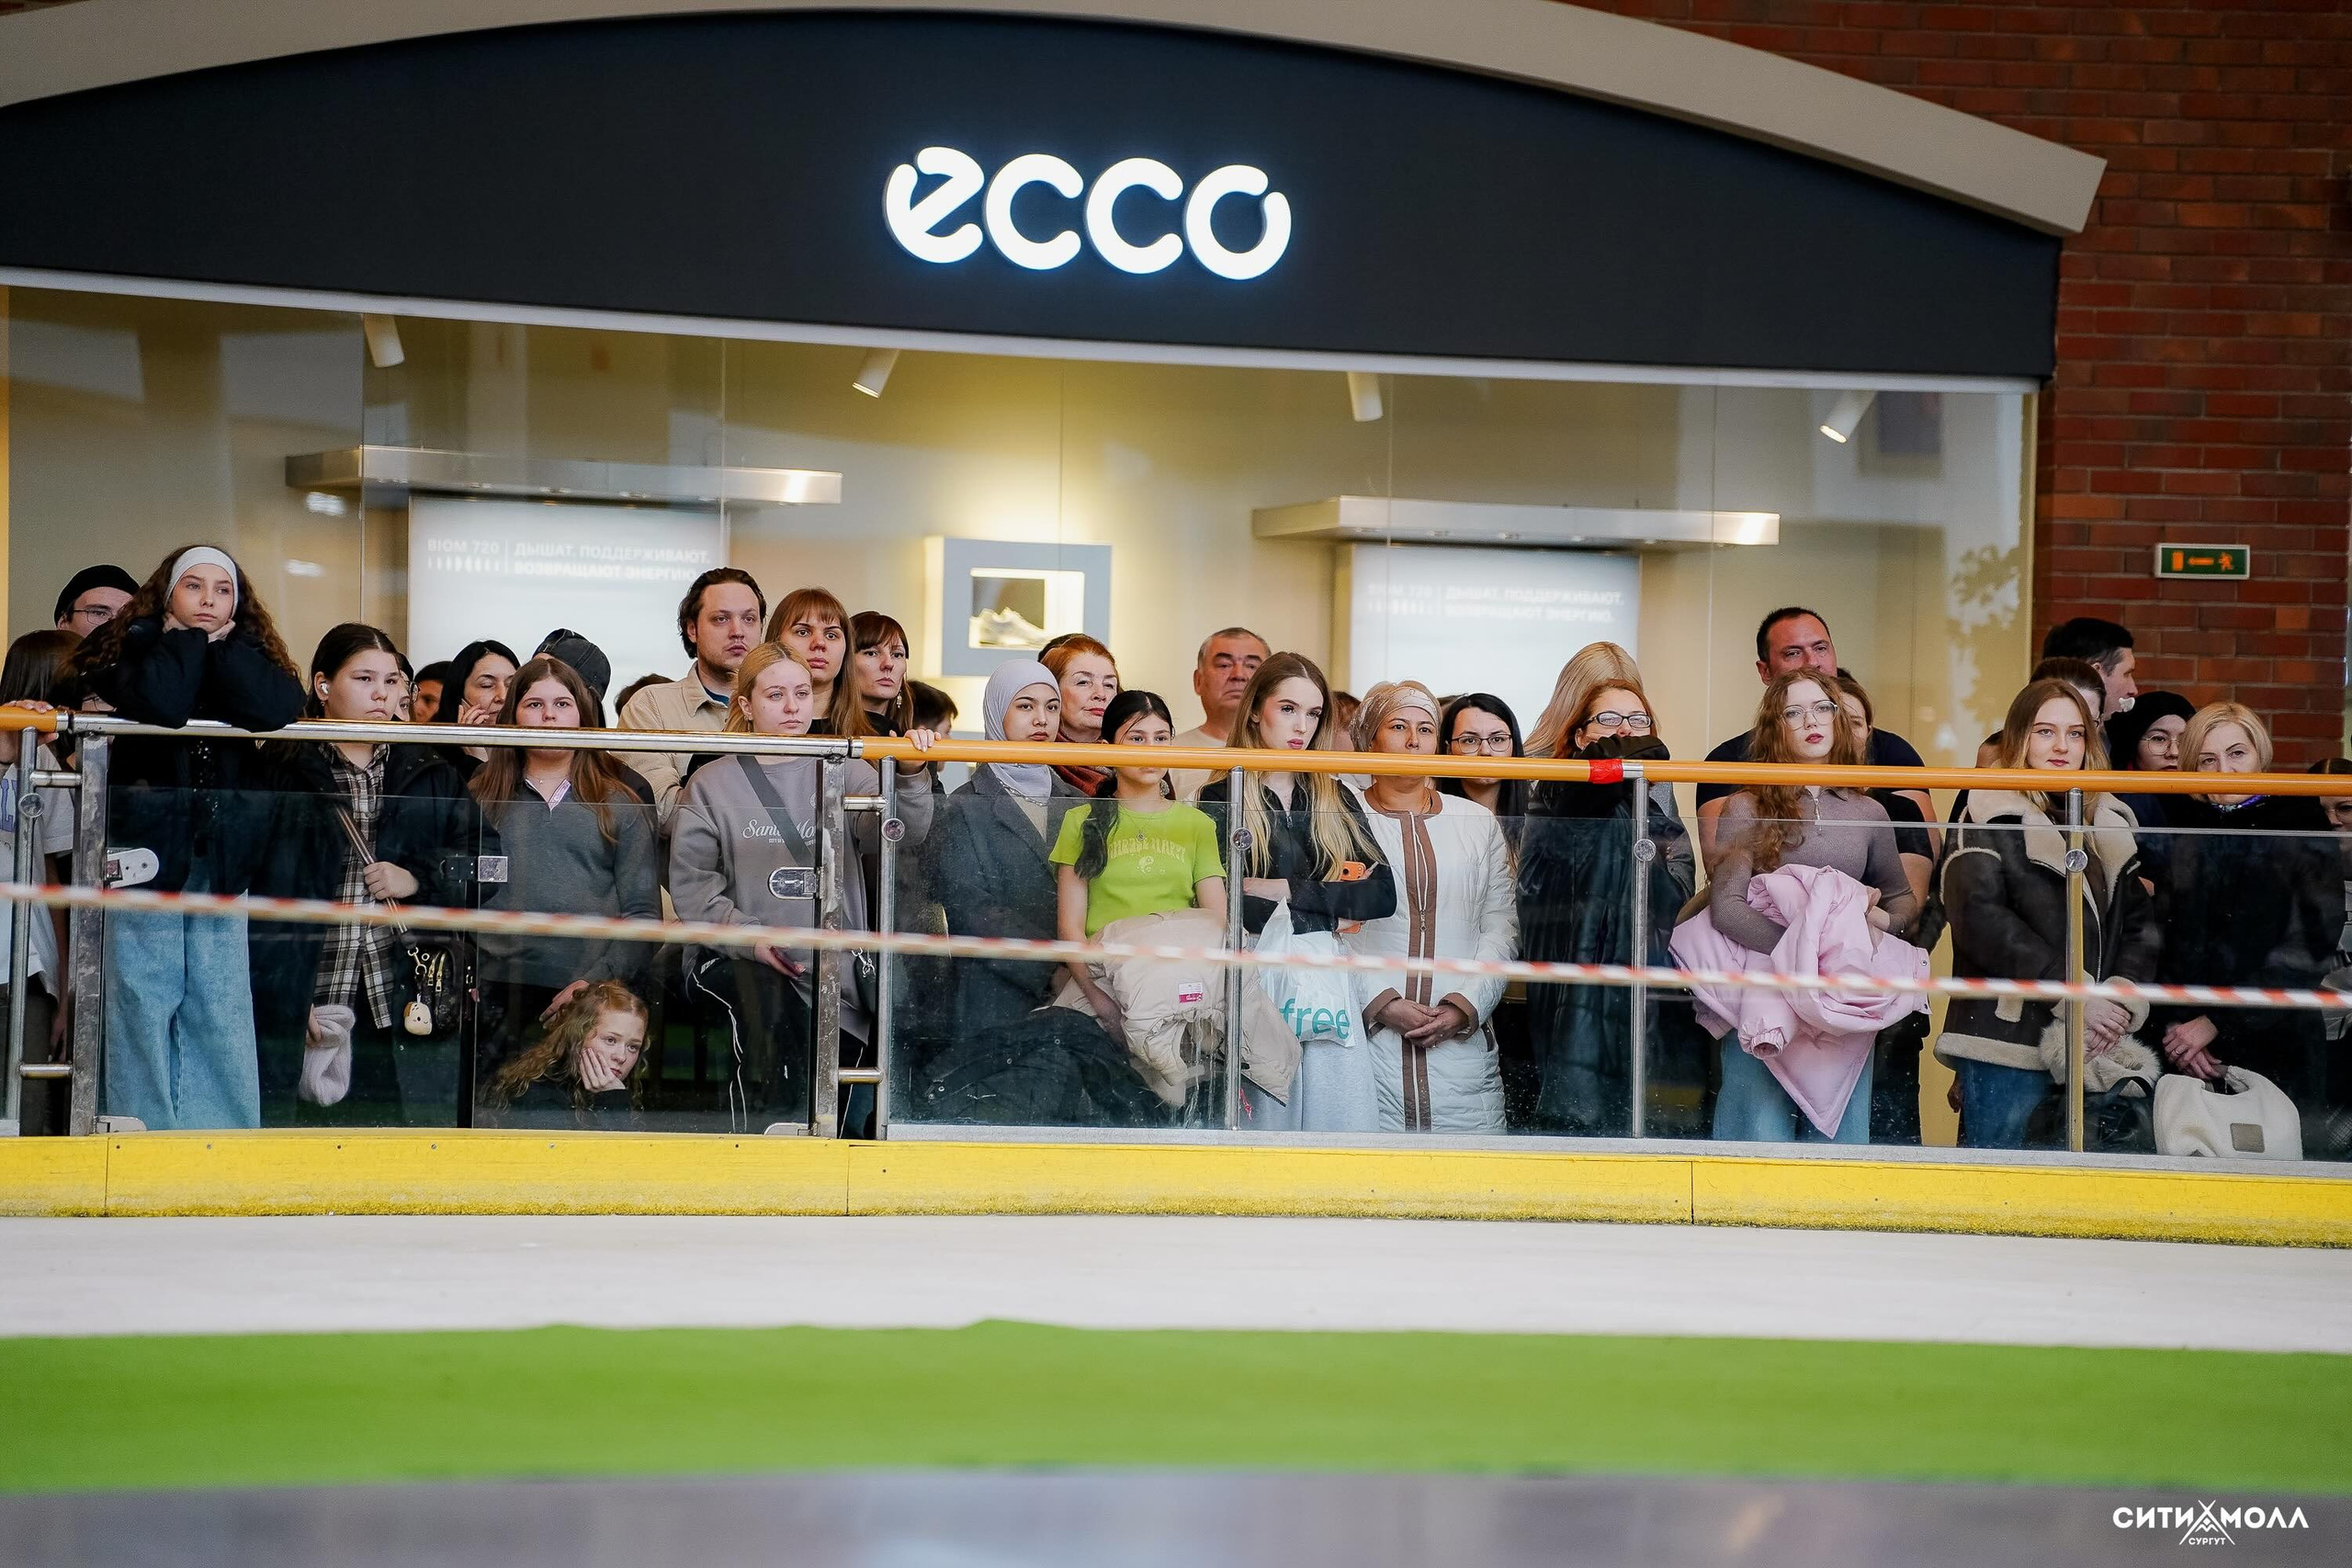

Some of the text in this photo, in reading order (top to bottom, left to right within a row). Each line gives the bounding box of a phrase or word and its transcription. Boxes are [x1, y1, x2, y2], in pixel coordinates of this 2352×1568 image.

[883, 146, 1292, 280] ecco
[427, 538, 500, 553] BIOM 720
[1278, 998, 1350, 1039] free
